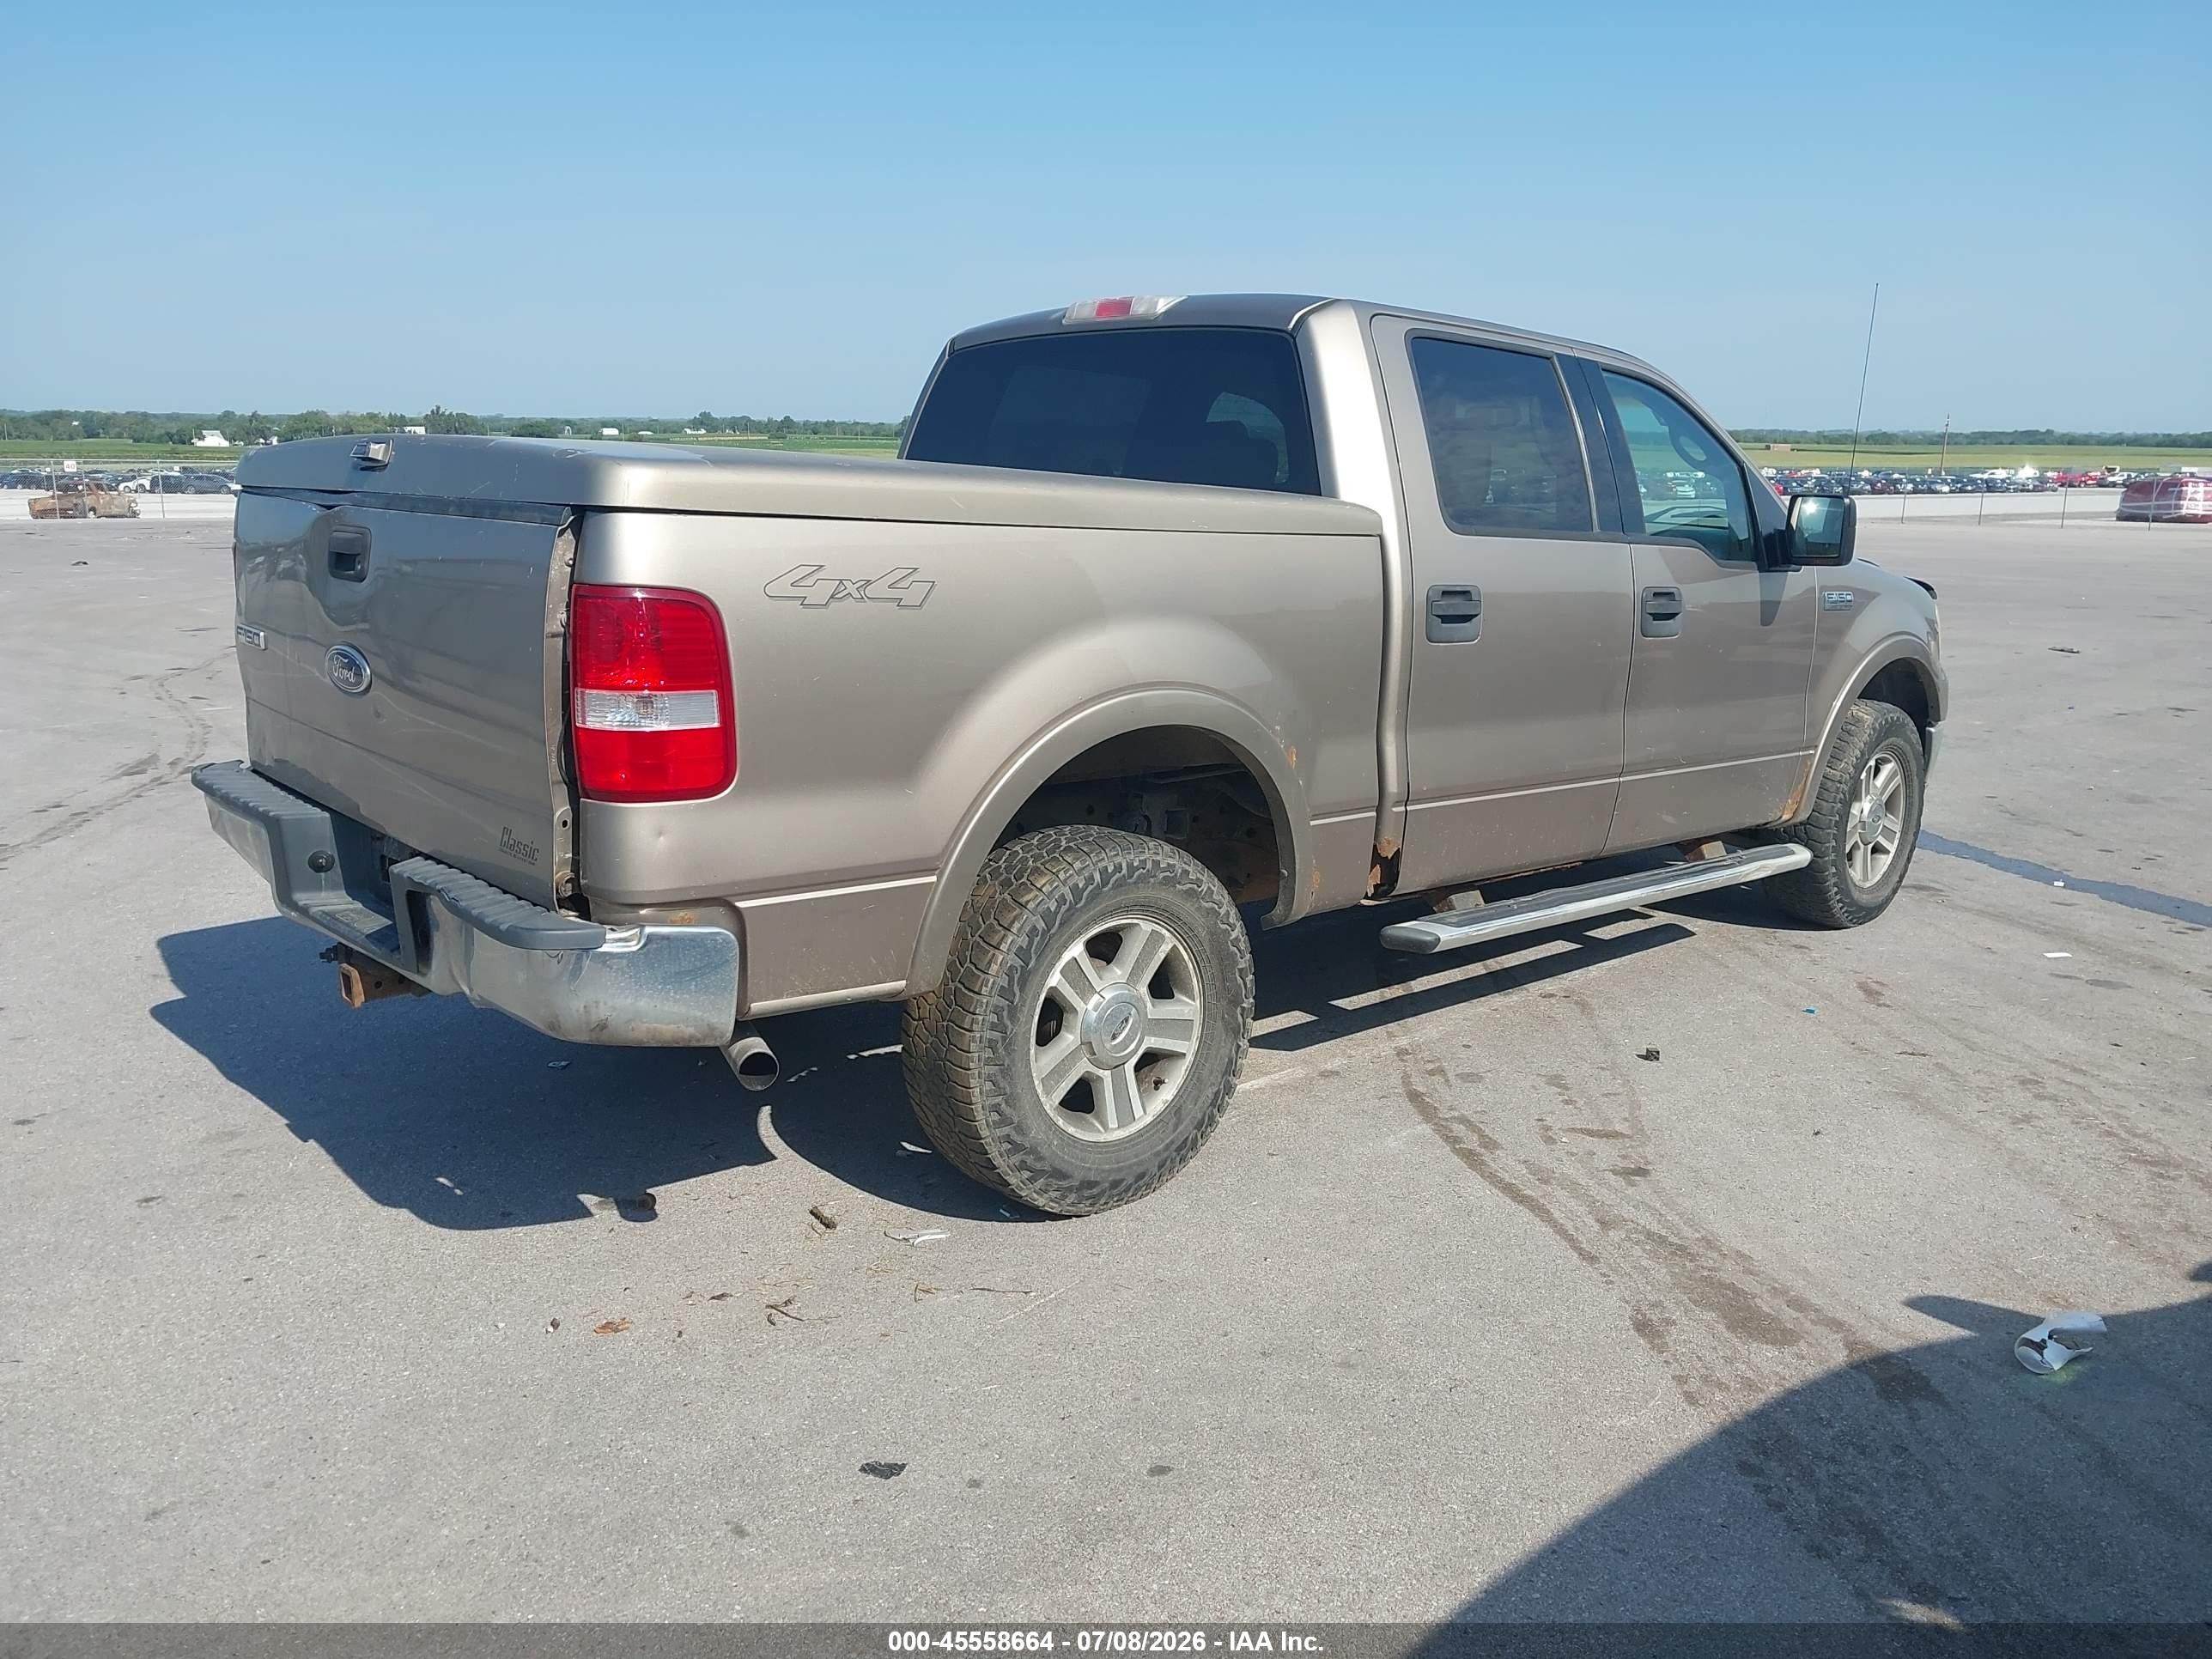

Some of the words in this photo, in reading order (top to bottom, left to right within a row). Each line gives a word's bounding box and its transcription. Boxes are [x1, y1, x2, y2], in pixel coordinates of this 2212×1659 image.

[763, 563, 936, 608] 4x4
[333, 653, 356, 684] Ford
[499, 826, 540, 862] Classic
